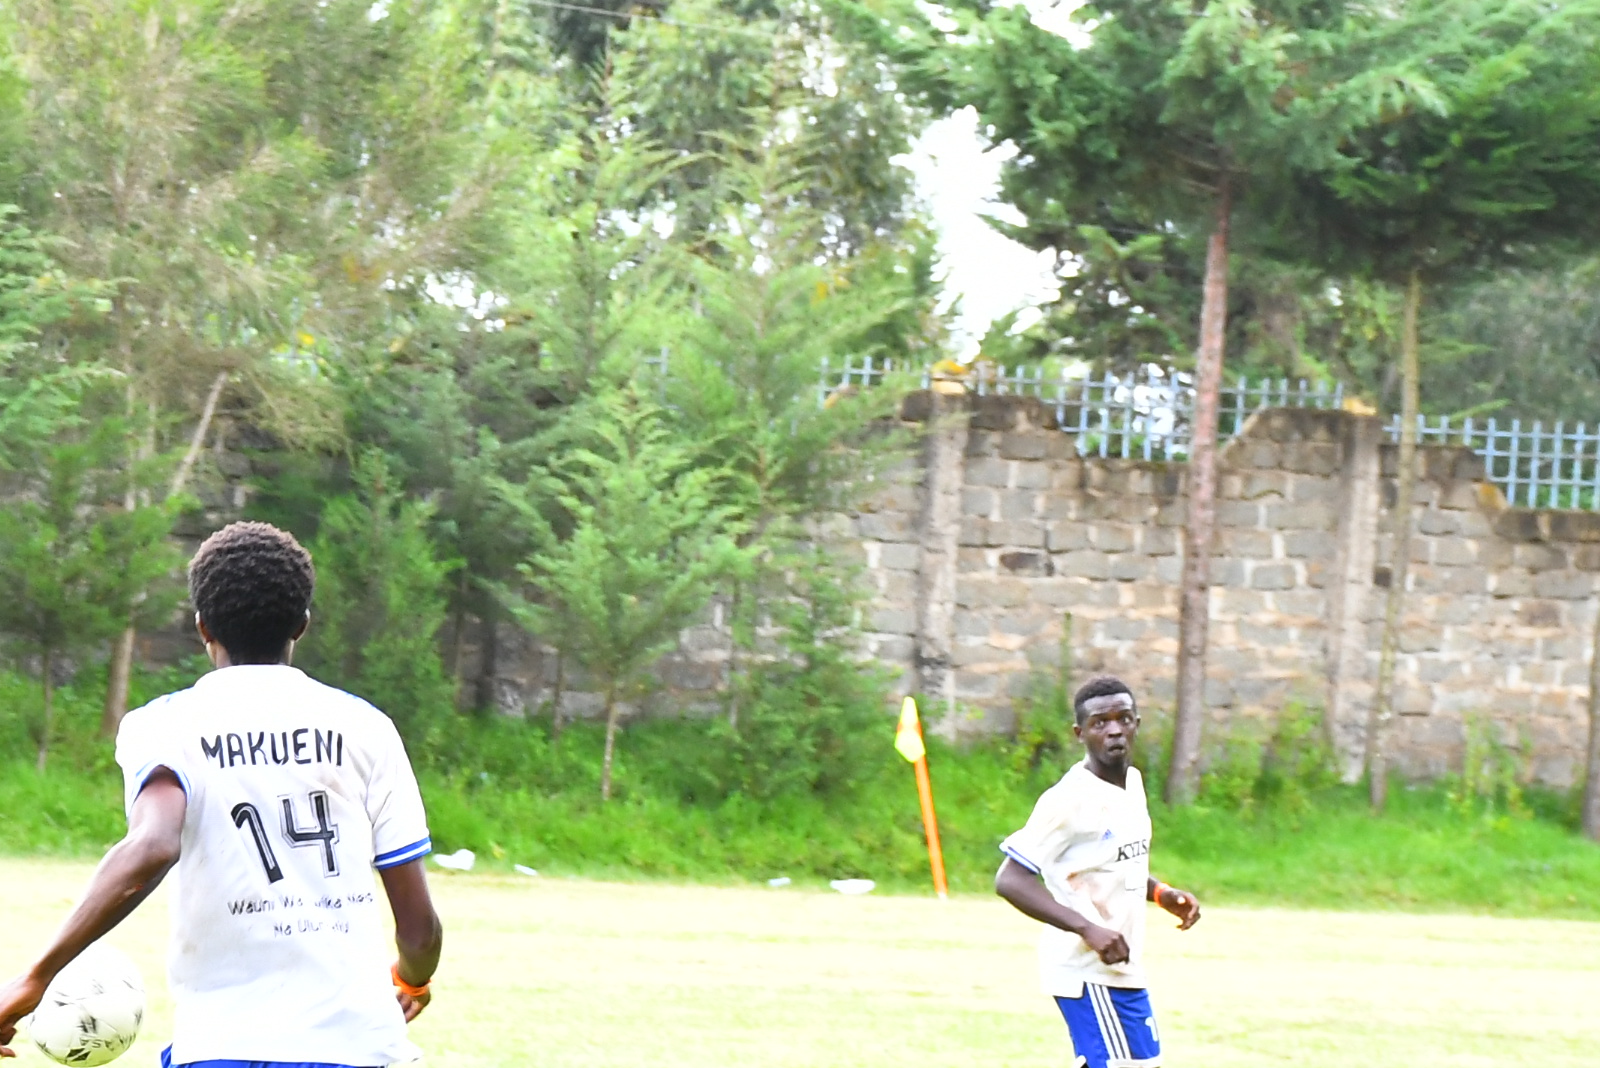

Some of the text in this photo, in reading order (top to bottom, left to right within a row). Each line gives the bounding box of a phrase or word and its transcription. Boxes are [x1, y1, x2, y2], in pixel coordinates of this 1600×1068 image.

[201, 728, 342, 768] MAKUENI
[230, 791, 340, 886] 14
[1114, 838, 1149, 863] KYIS
